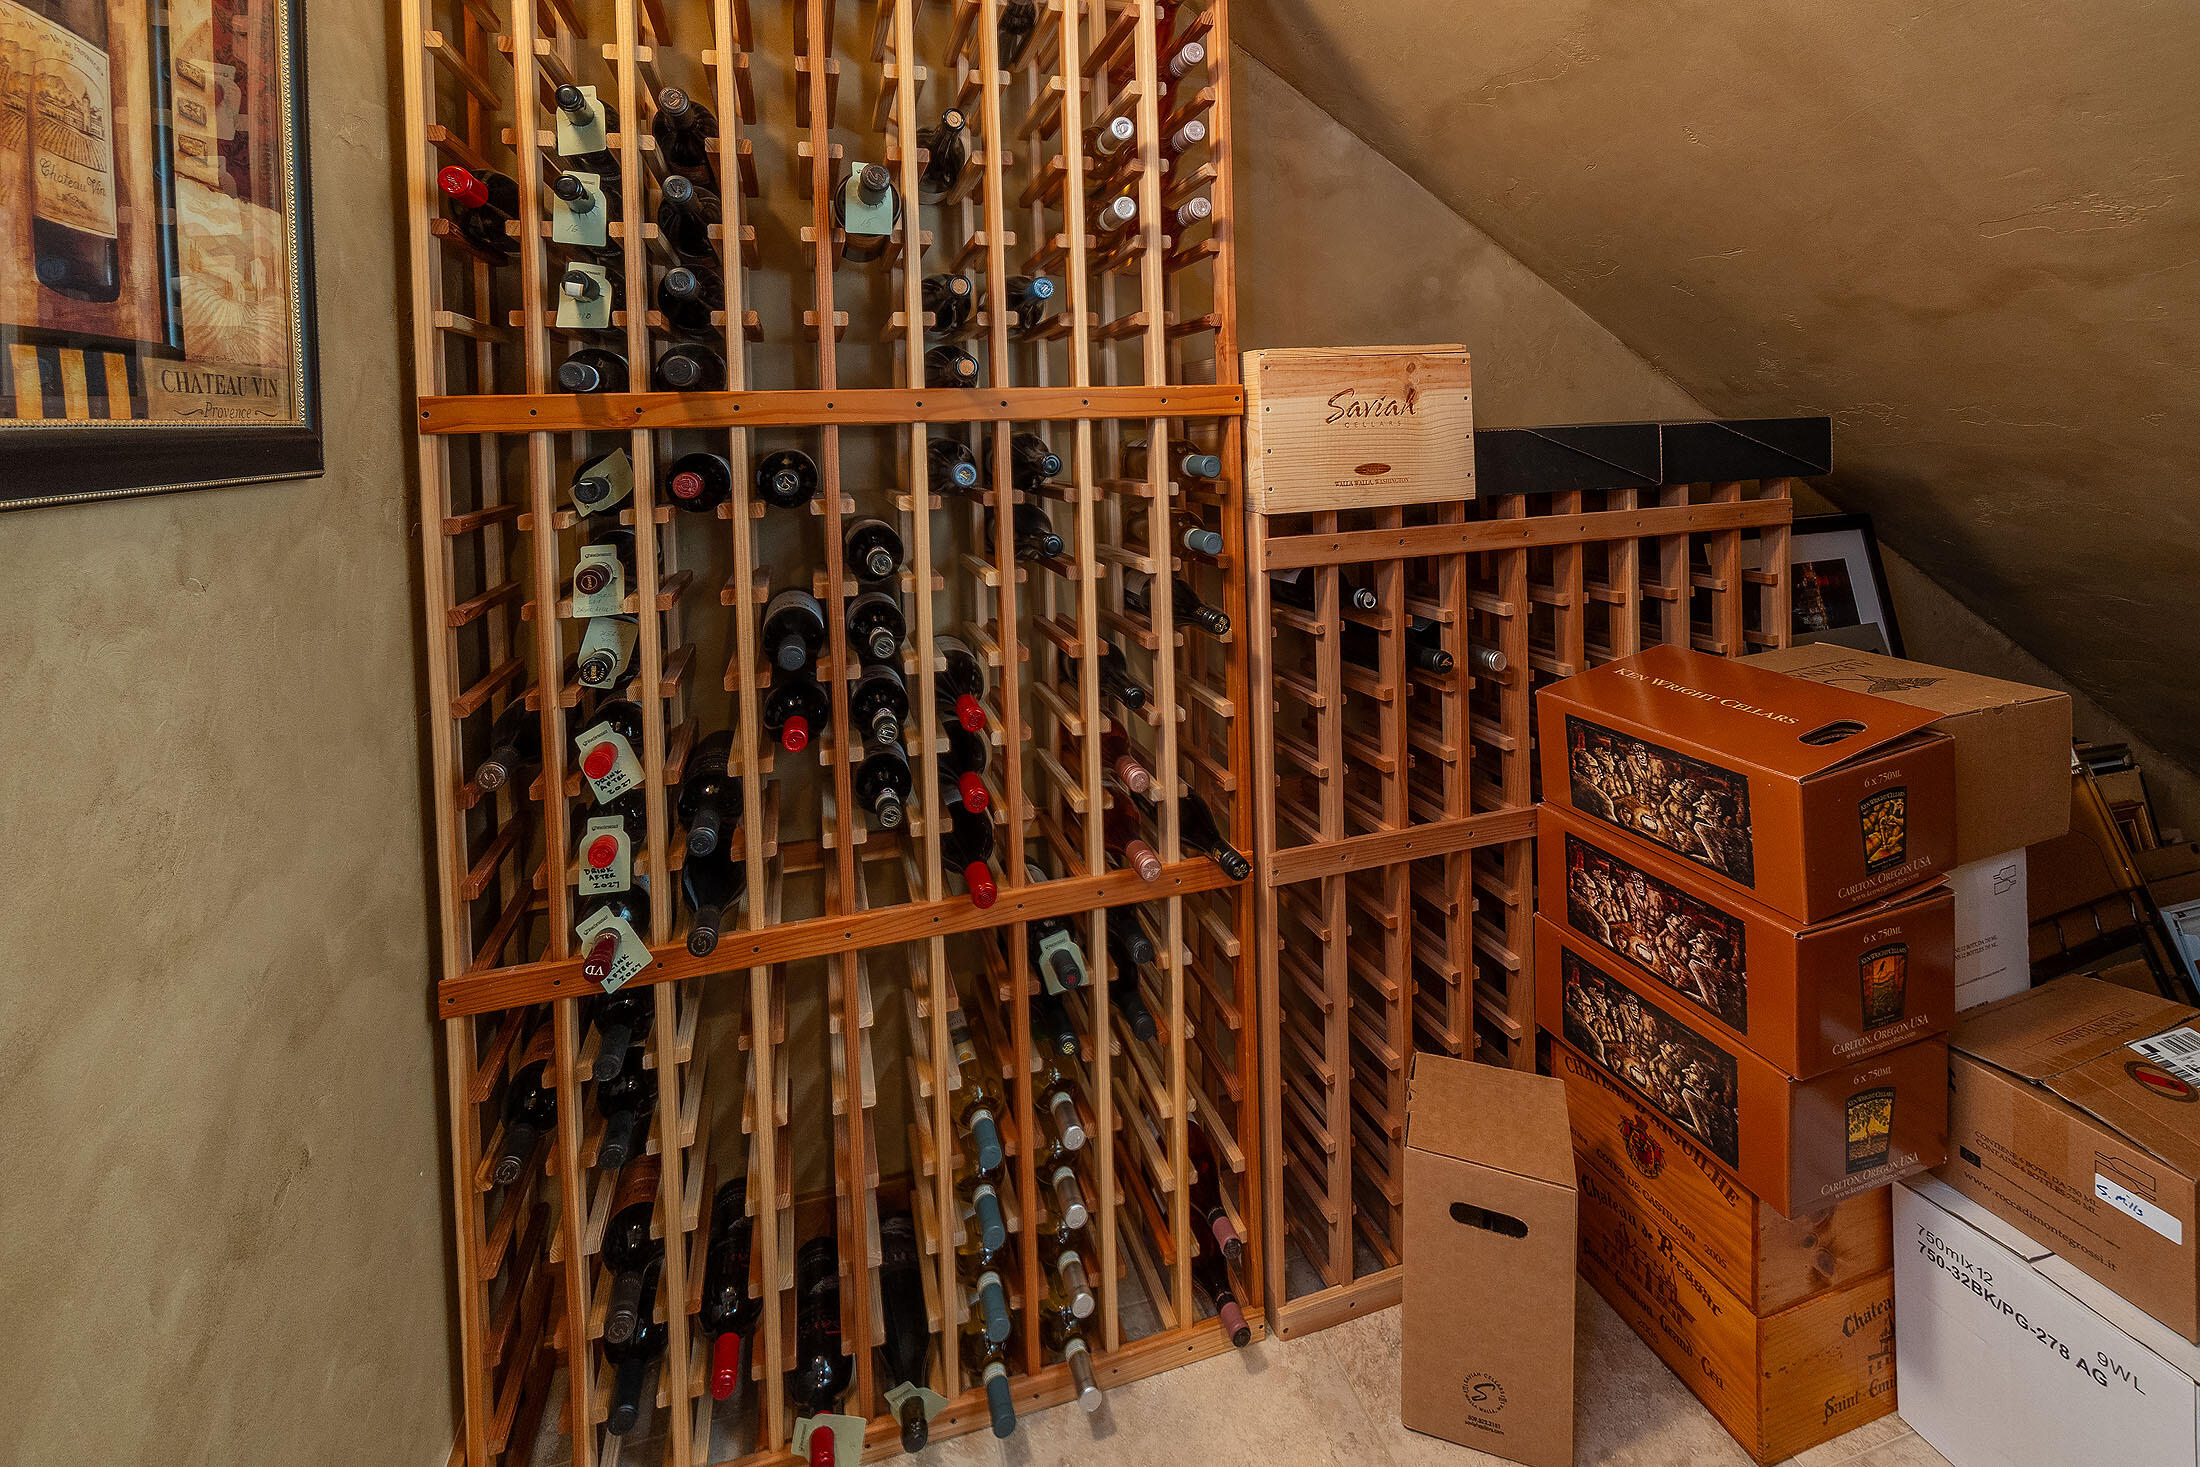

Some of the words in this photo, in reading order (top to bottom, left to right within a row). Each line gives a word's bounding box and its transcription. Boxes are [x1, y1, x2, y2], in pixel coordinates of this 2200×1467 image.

[161, 369, 247, 396] CHATEAU
[252, 377, 278, 397] VIN
[204, 402, 251, 418] Provence
[1325, 388, 1417, 424] Saviah
[1344, 420, 1402, 429] CELLARS
[1614, 667, 1649, 681] KEN
[1651, 677, 1720, 701] WRIGHT
[1720, 698, 1799, 725] CELLARS
[594, 769, 622, 787] DRINK
[600, 773, 627, 791] AFTER
[608, 779, 632, 795] 2027
[1864, 779, 1870, 788] 6
[584, 866, 614, 876] DRINK
[589, 872, 616, 881] AFTER
[1878, 863, 1914, 884] OREGON
[1914, 855, 1932, 869] USA
[593, 881, 620, 889] 2027
[1864, 934, 1869, 944] 6
[585, 965, 604, 976] VD
[611, 954, 629, 970] INK
[606, 961, 633, 984] AFTER
[619, 963, 642, 982] 2027
[1873, 1022, 1909, 1041] OREGON
[1909, 1013, 1929, 1029] USA
[1854, 1073, 1859, 1084] 6
[1863, 1160, 1899, 1180] OREGON
[1900, 1151, 1919, 1166] USA
[1975, 1131, 2018, 1158] CONTIENE
[2052, 1175, 2065, 1188] DA
[2084, 1194, 2101, 1209] ML
[1976, 1139, 2019, 1169] CONTAINS
[2083, 1202, 2101, 1217] ML
[1627, 1175, 1641, 1193] DE
[1643, 1190, 1697, 1242] CASTILLON
[1705, 1243, 1728, 1270] 2005
[1641, 1222, 1654, 1243] de
[1917, 1240, 2071, 1361] 750-32BK/PG-278
[2075, 1357, 2109, 1388] AG
[2096, 1350, 2148, 1396] 9WL
